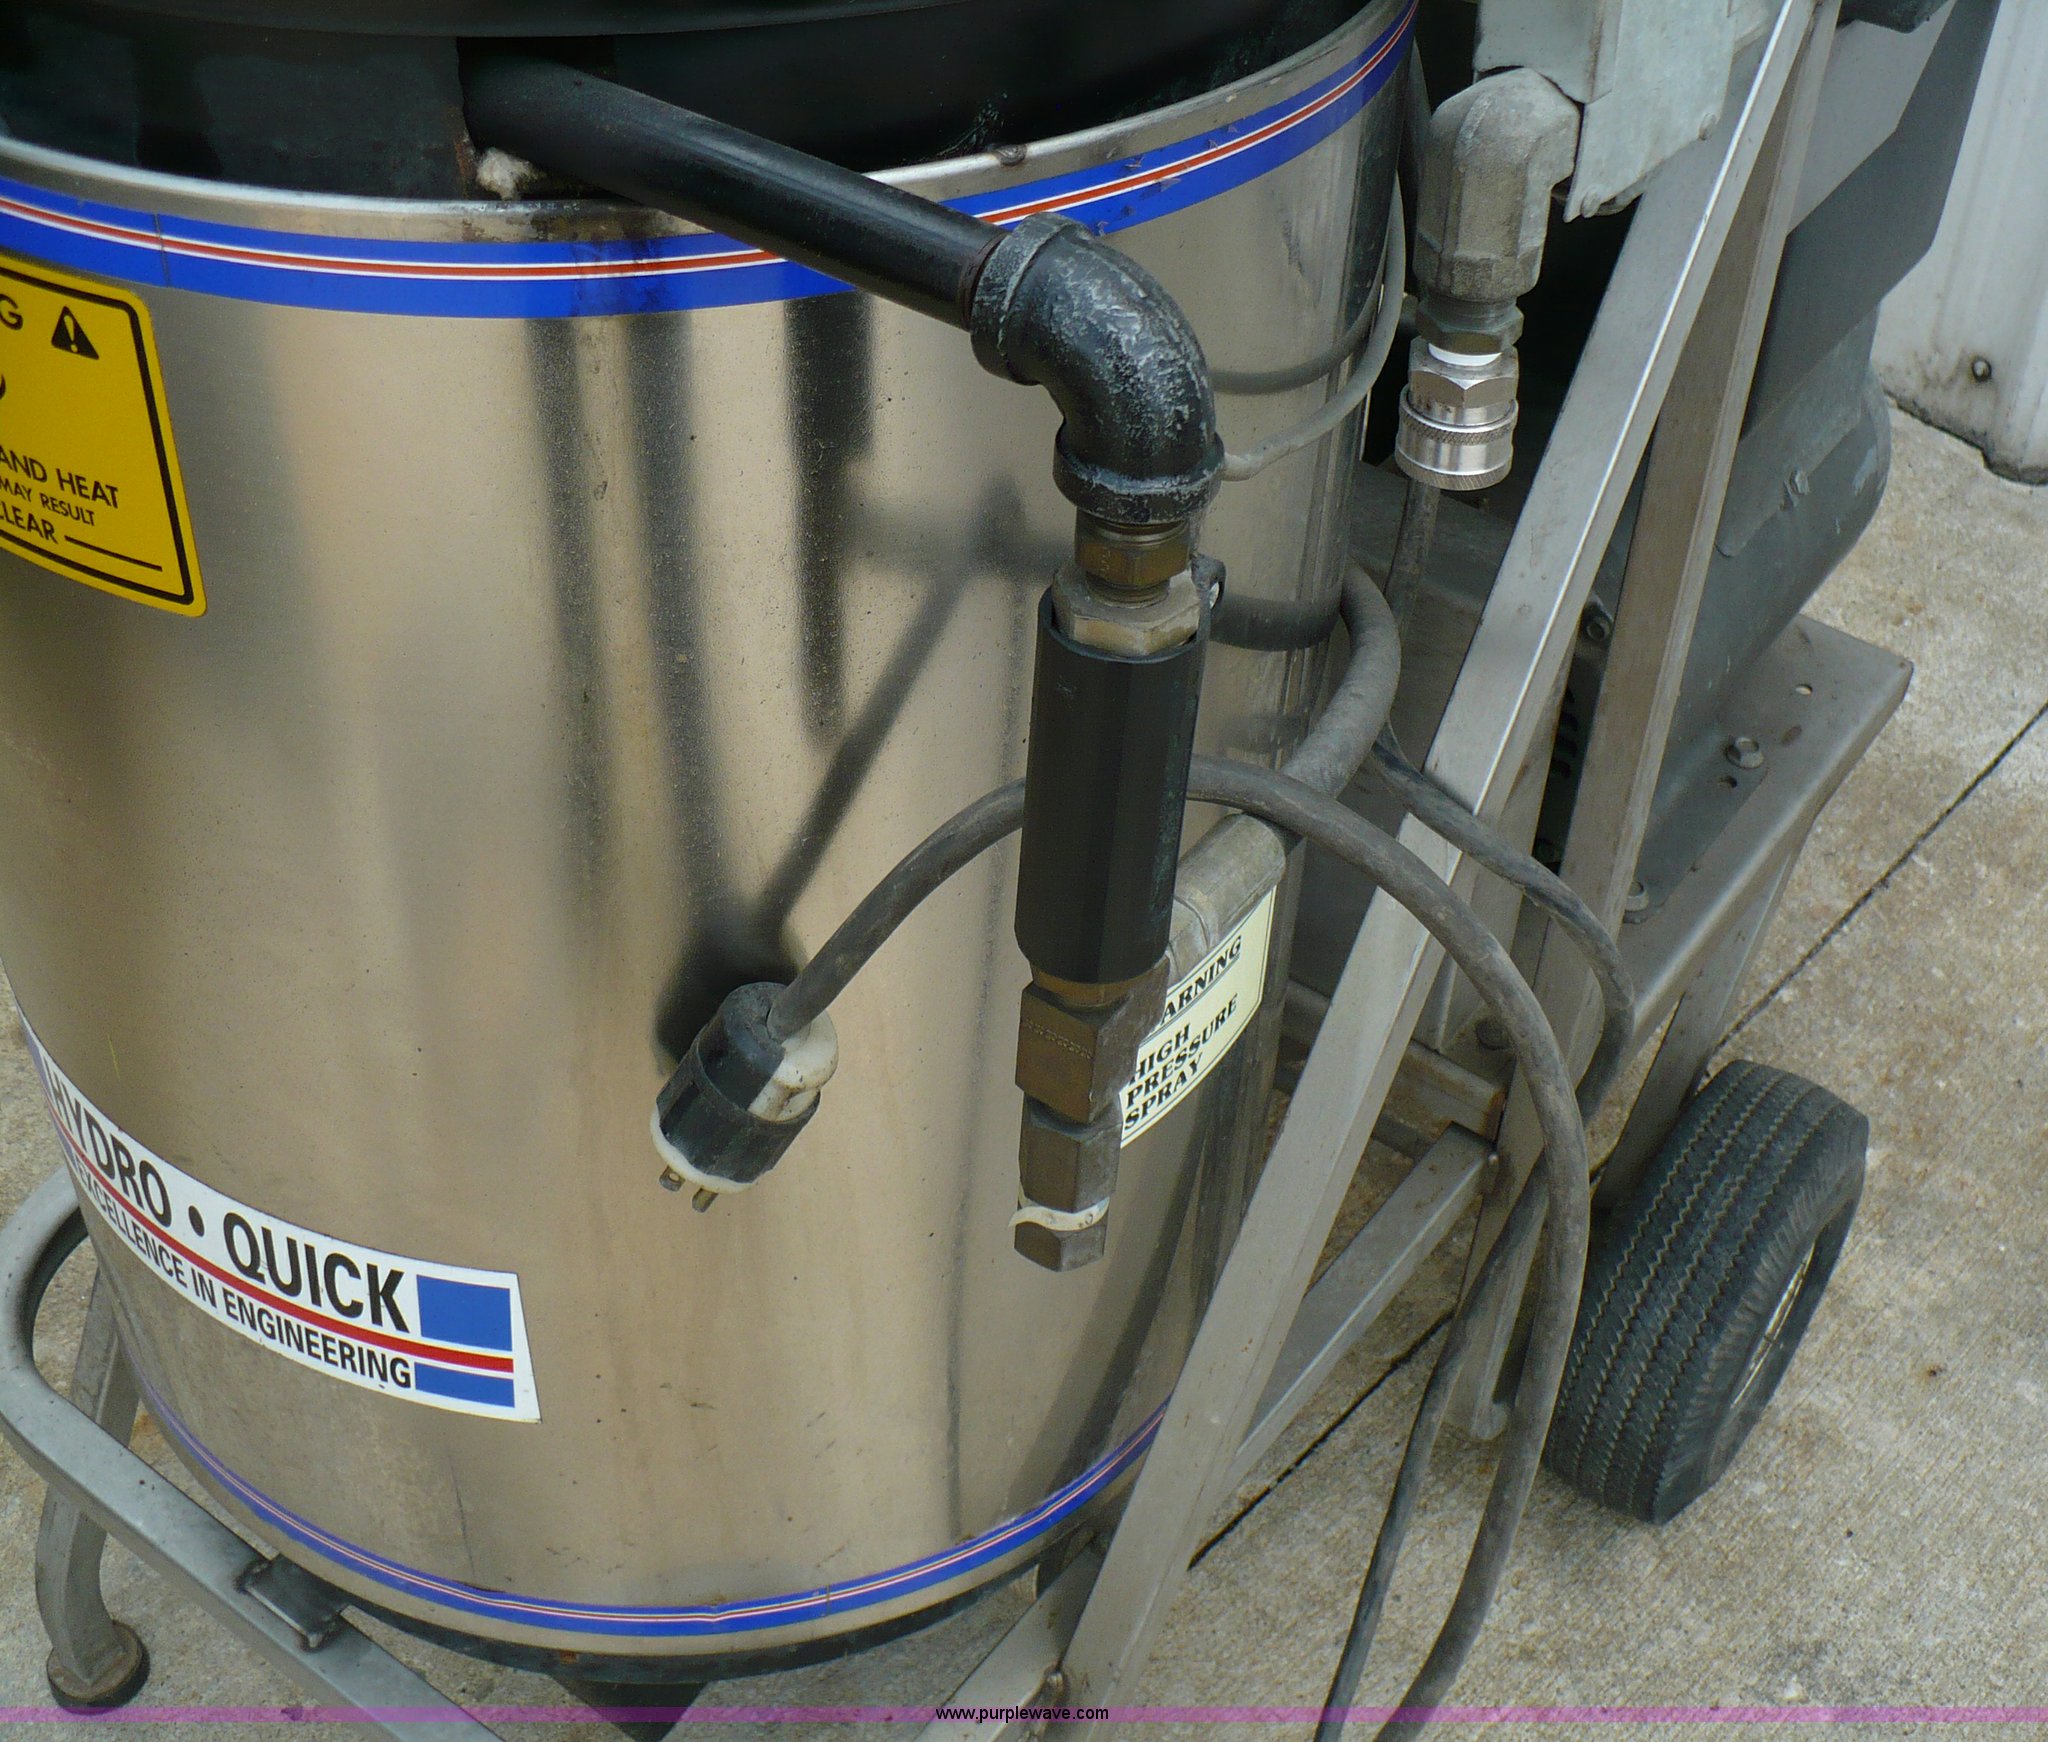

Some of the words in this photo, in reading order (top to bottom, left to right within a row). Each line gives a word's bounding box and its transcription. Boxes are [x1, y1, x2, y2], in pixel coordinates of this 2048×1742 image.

[39, 492, 95, 526] RESULT
[56, 468, 118, 509] HEAT
[1161, 935, 1242, 1025] ARNING
[1124, 1052, 1204, 1130] SPRAY
[1126, 993, 1238, 1110] PRESSURE
[1127, 1023, 1190, 1085] HIGH
[44, 1056, 172, 1228] HYDRO
[222, 1211, 410, 1334] QUICK
[75, 1155, 188, 1289] EXCELLENCE
[191, 1266, 217, 1308] IN
[225, 1287, 412, 1389] ENGINEERING
